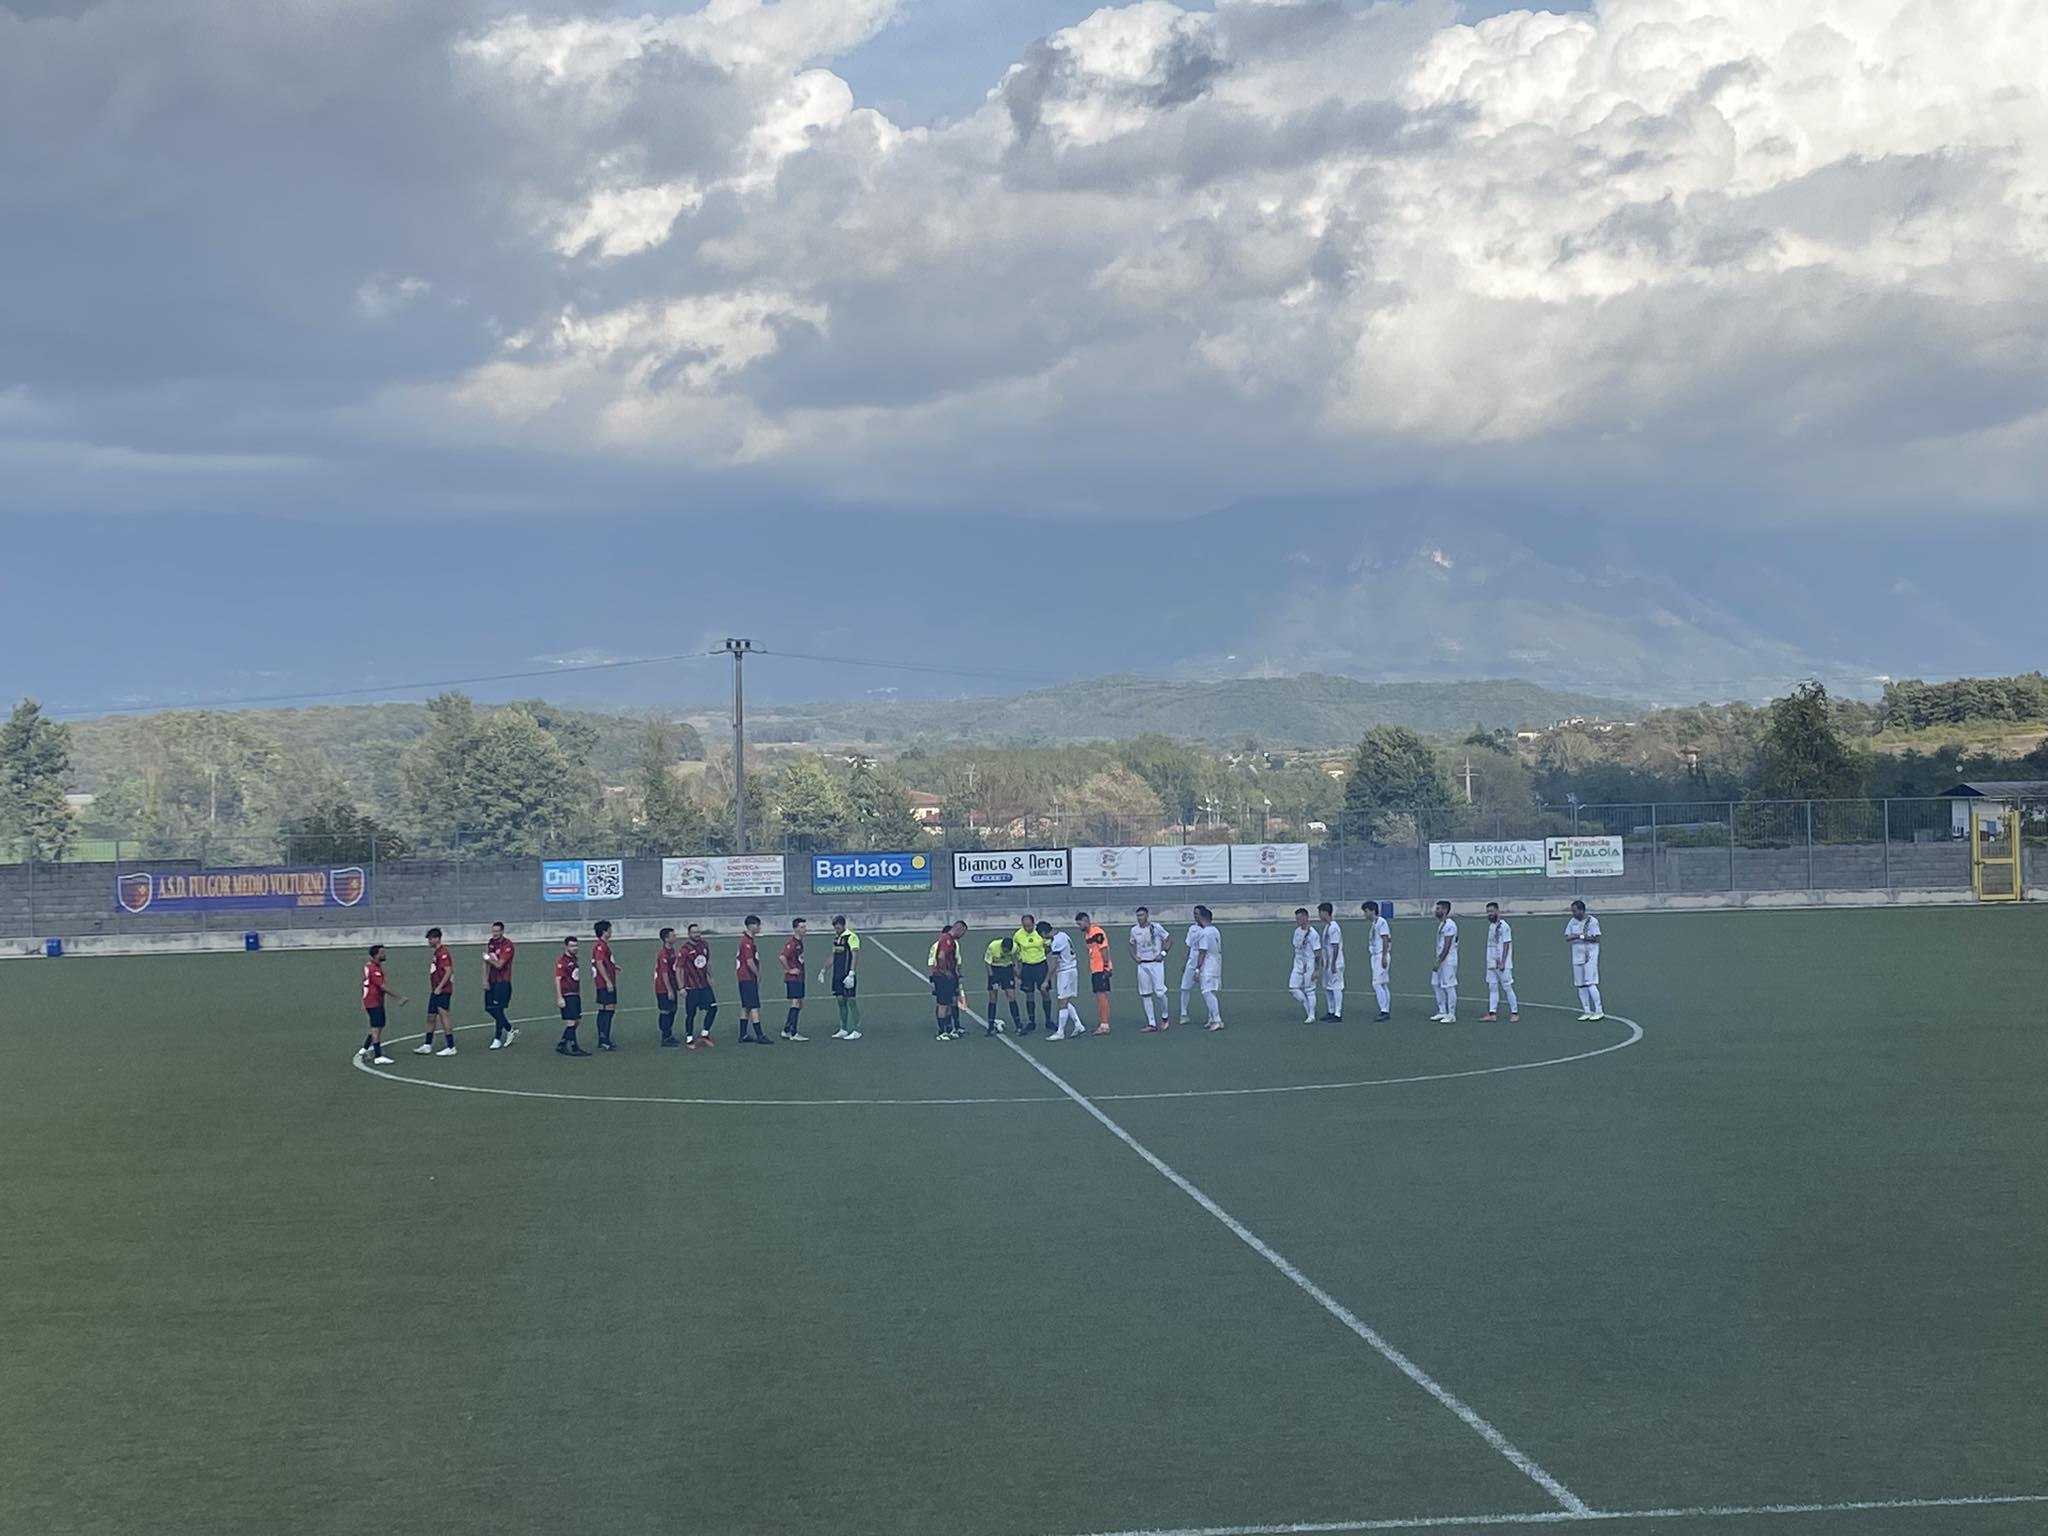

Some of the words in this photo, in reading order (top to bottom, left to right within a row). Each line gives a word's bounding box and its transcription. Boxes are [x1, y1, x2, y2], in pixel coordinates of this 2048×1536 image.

[1474, 844, 1527, 854] FARMACIA
[816, 859, 902, 878] Barbato
[958, 856, 1007, 872] Bianco
[1011, 856, 1025, 870] &
[1029, 853, 1063, 869] Nero
[1467, 854, 1536, 866] ANDRISANI
[189, 874, 231, 897] FULGOR
[233, 873, 268, 896] MEDIO
[269, 872, 326, 895] VOLTURNO
